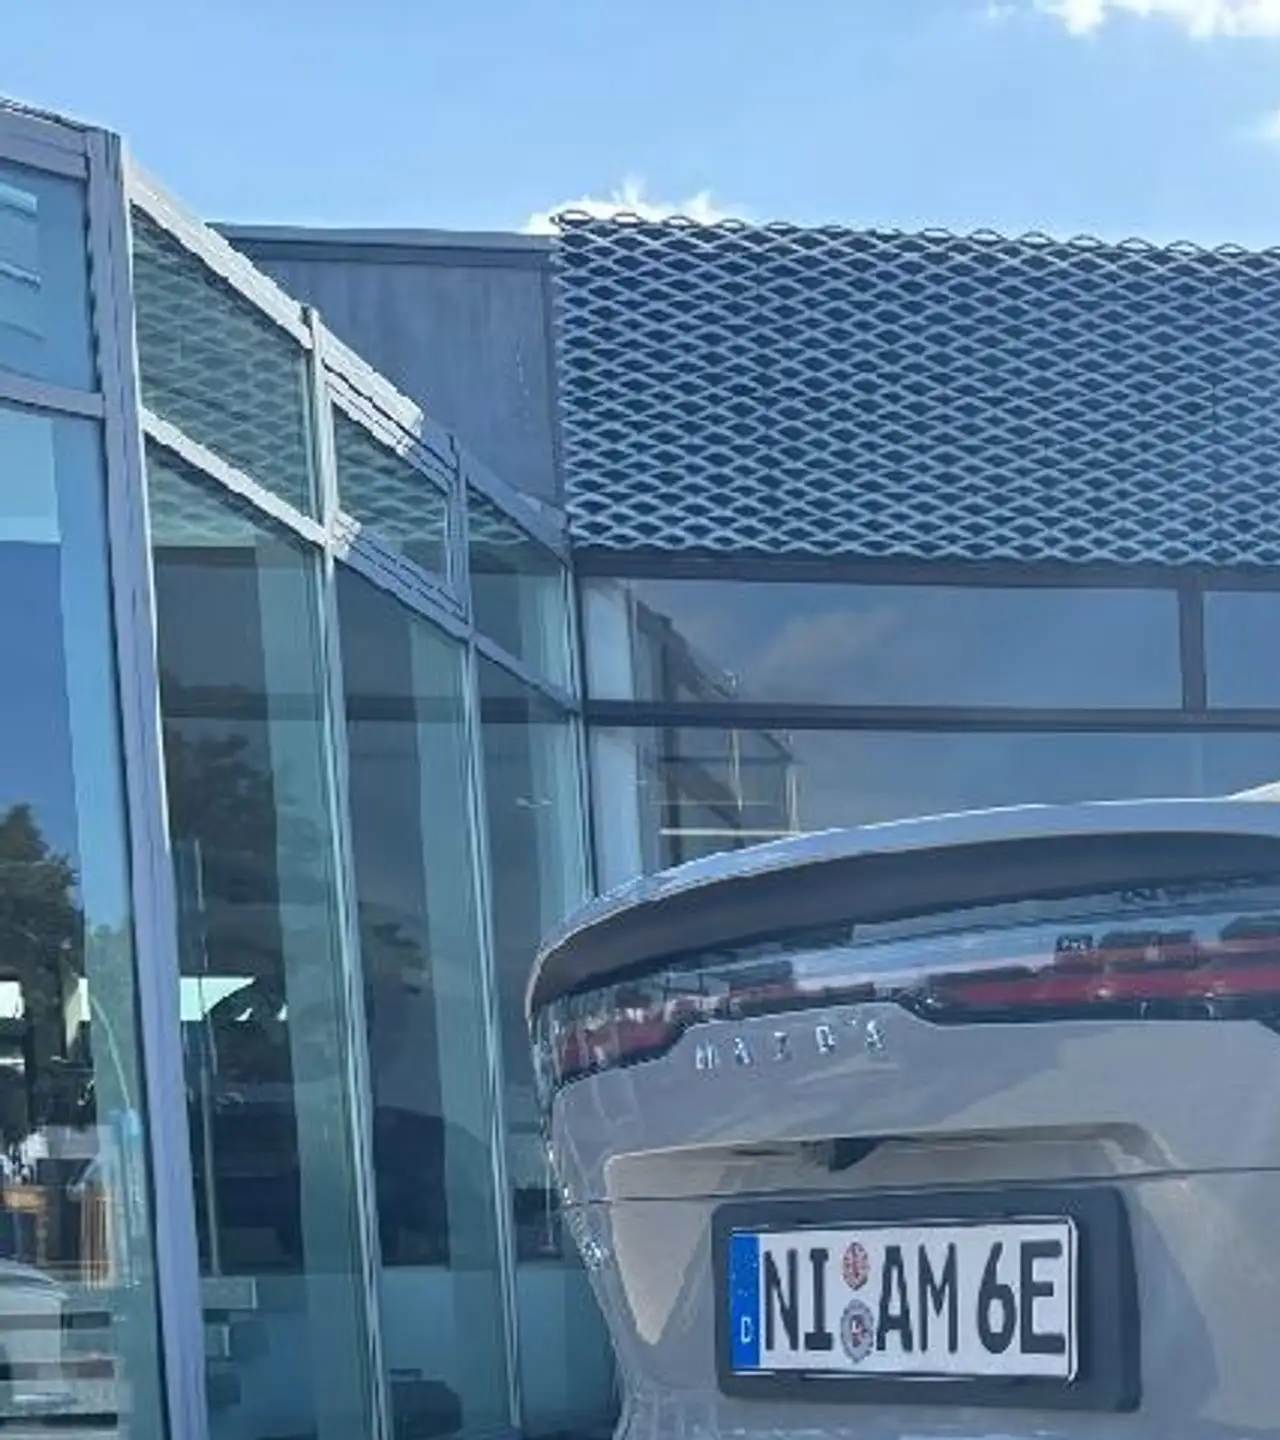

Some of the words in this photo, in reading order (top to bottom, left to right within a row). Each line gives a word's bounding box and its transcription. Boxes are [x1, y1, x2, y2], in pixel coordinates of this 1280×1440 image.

[764, 1248, 833, 1351] NI
[876, 1245, 958, 1354] AM
[977, 1239, 1066, 1354] 6E
